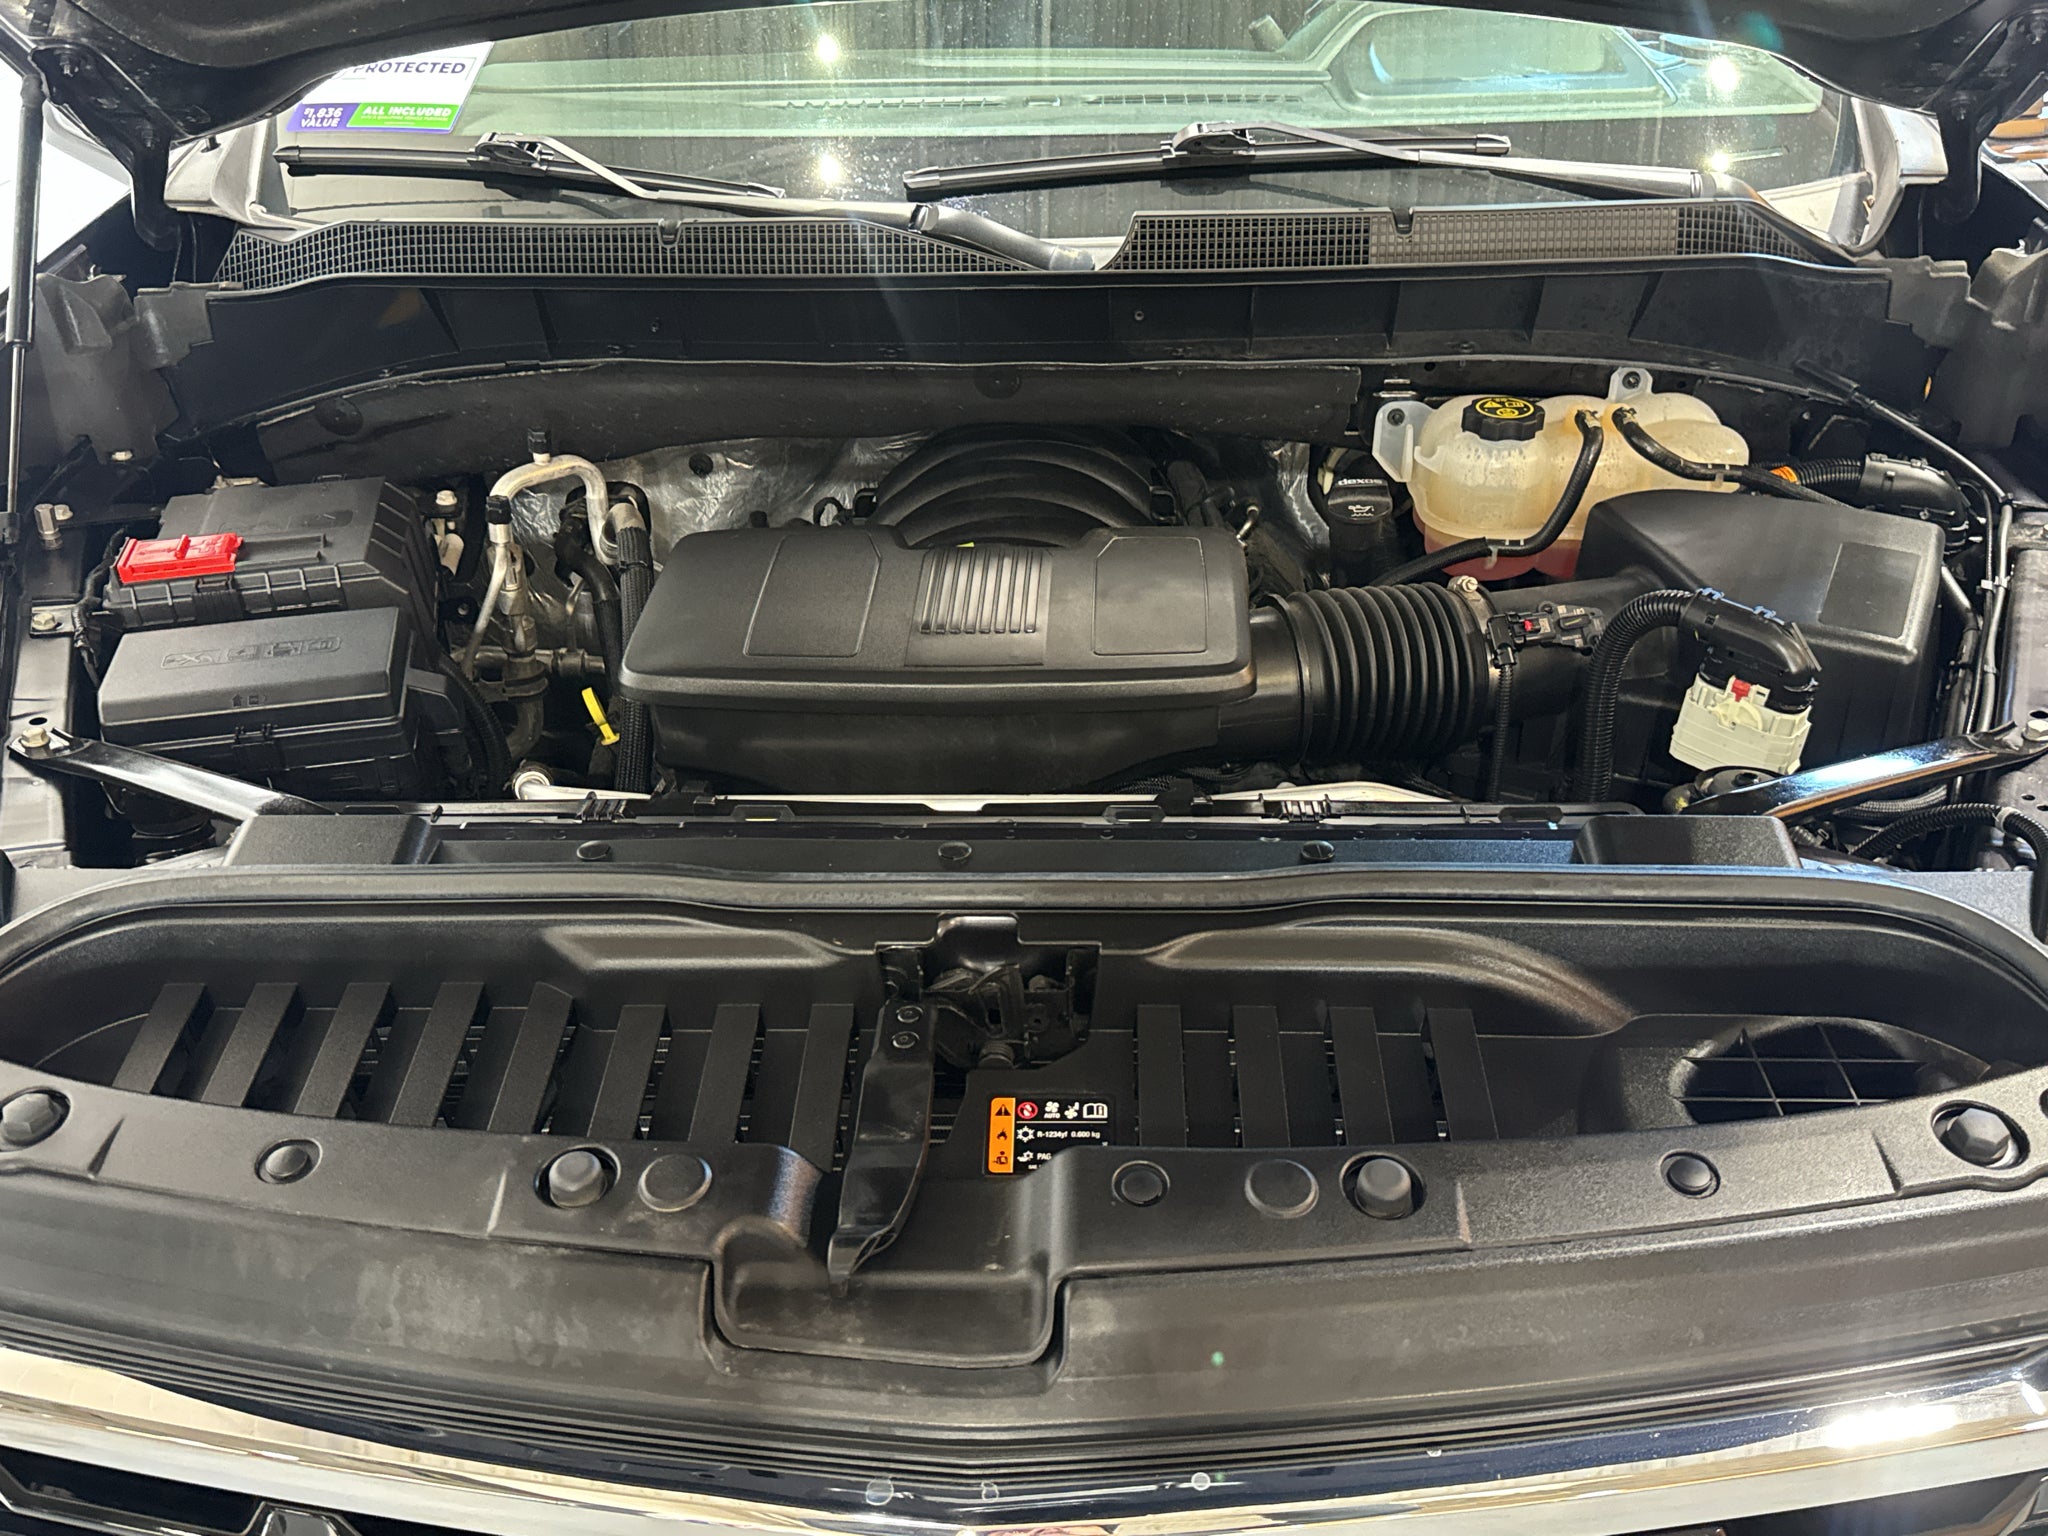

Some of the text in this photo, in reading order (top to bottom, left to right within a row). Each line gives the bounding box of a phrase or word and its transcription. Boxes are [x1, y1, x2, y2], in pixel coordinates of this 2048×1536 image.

[362, 106, 452, 117] ALL INCLUDED
[301, 117, 341, 128] VALUE
[1337, 478, 1383, 486] dexos
[1037, 1131, 1068, 1139] R-1234yf
[1091, 1131, 1101, 1139] kg
